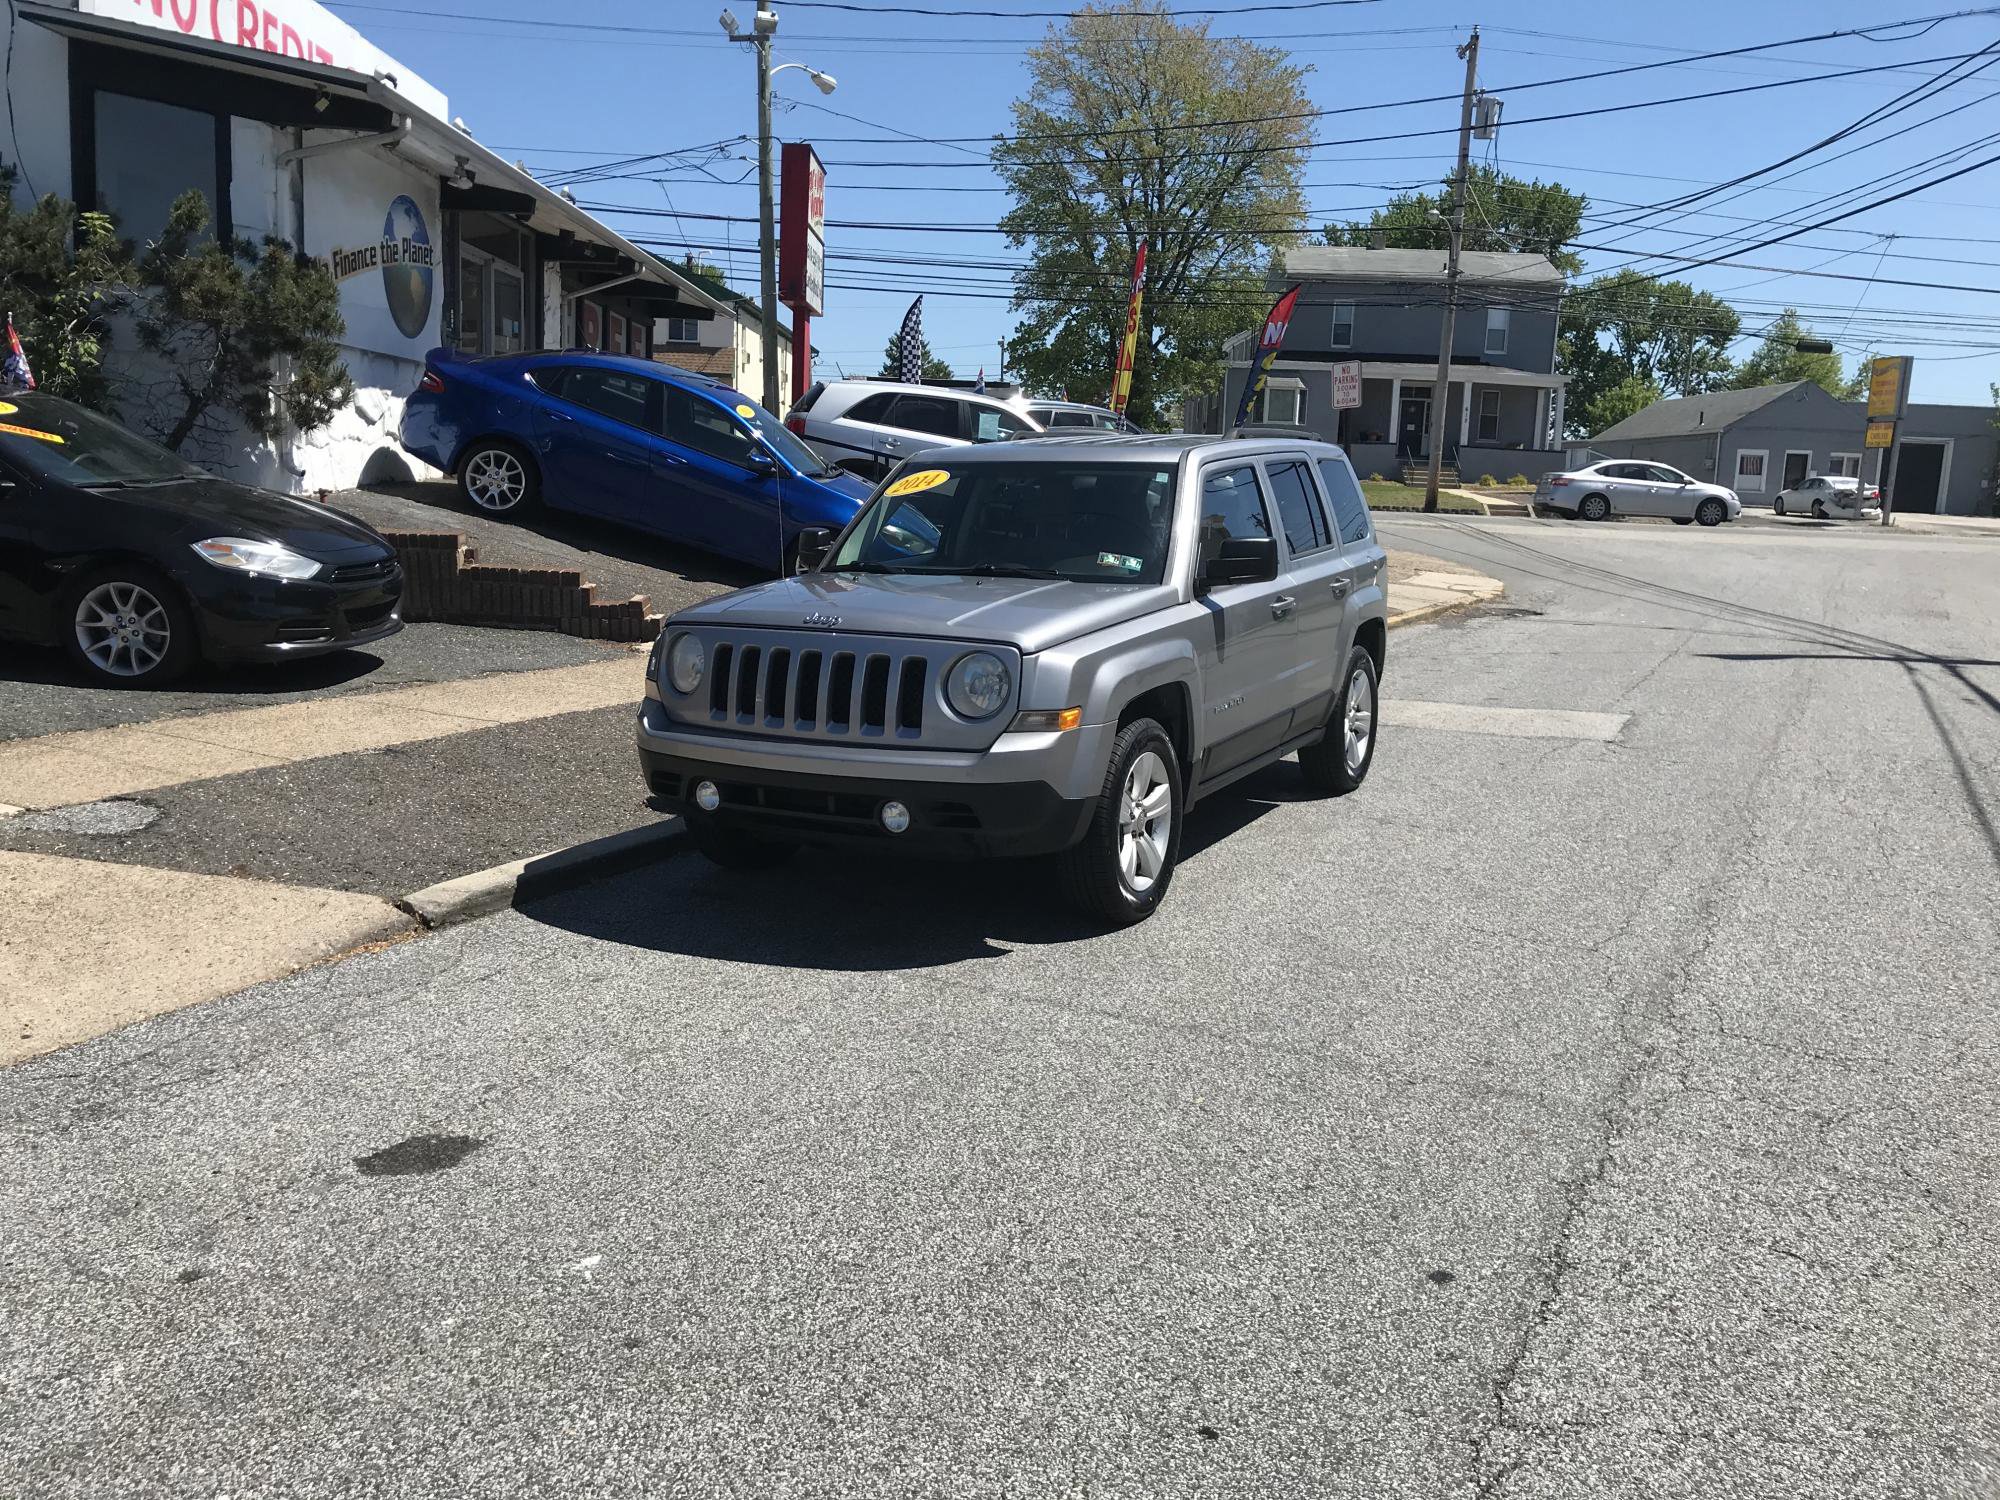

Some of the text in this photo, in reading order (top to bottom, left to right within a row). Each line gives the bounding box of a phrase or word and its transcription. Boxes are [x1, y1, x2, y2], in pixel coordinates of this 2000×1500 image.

[332, 246, 378, 280] Finance
[380, 238, 399, 265] the
[402, 236, 434, 266] Planet
[1341, 365, 1351, 375] NO
[1334, 374, 1359, 385] PARKING
[890, 473, 942, 493] 2014
[803, 612, 842, 628] Jeep
